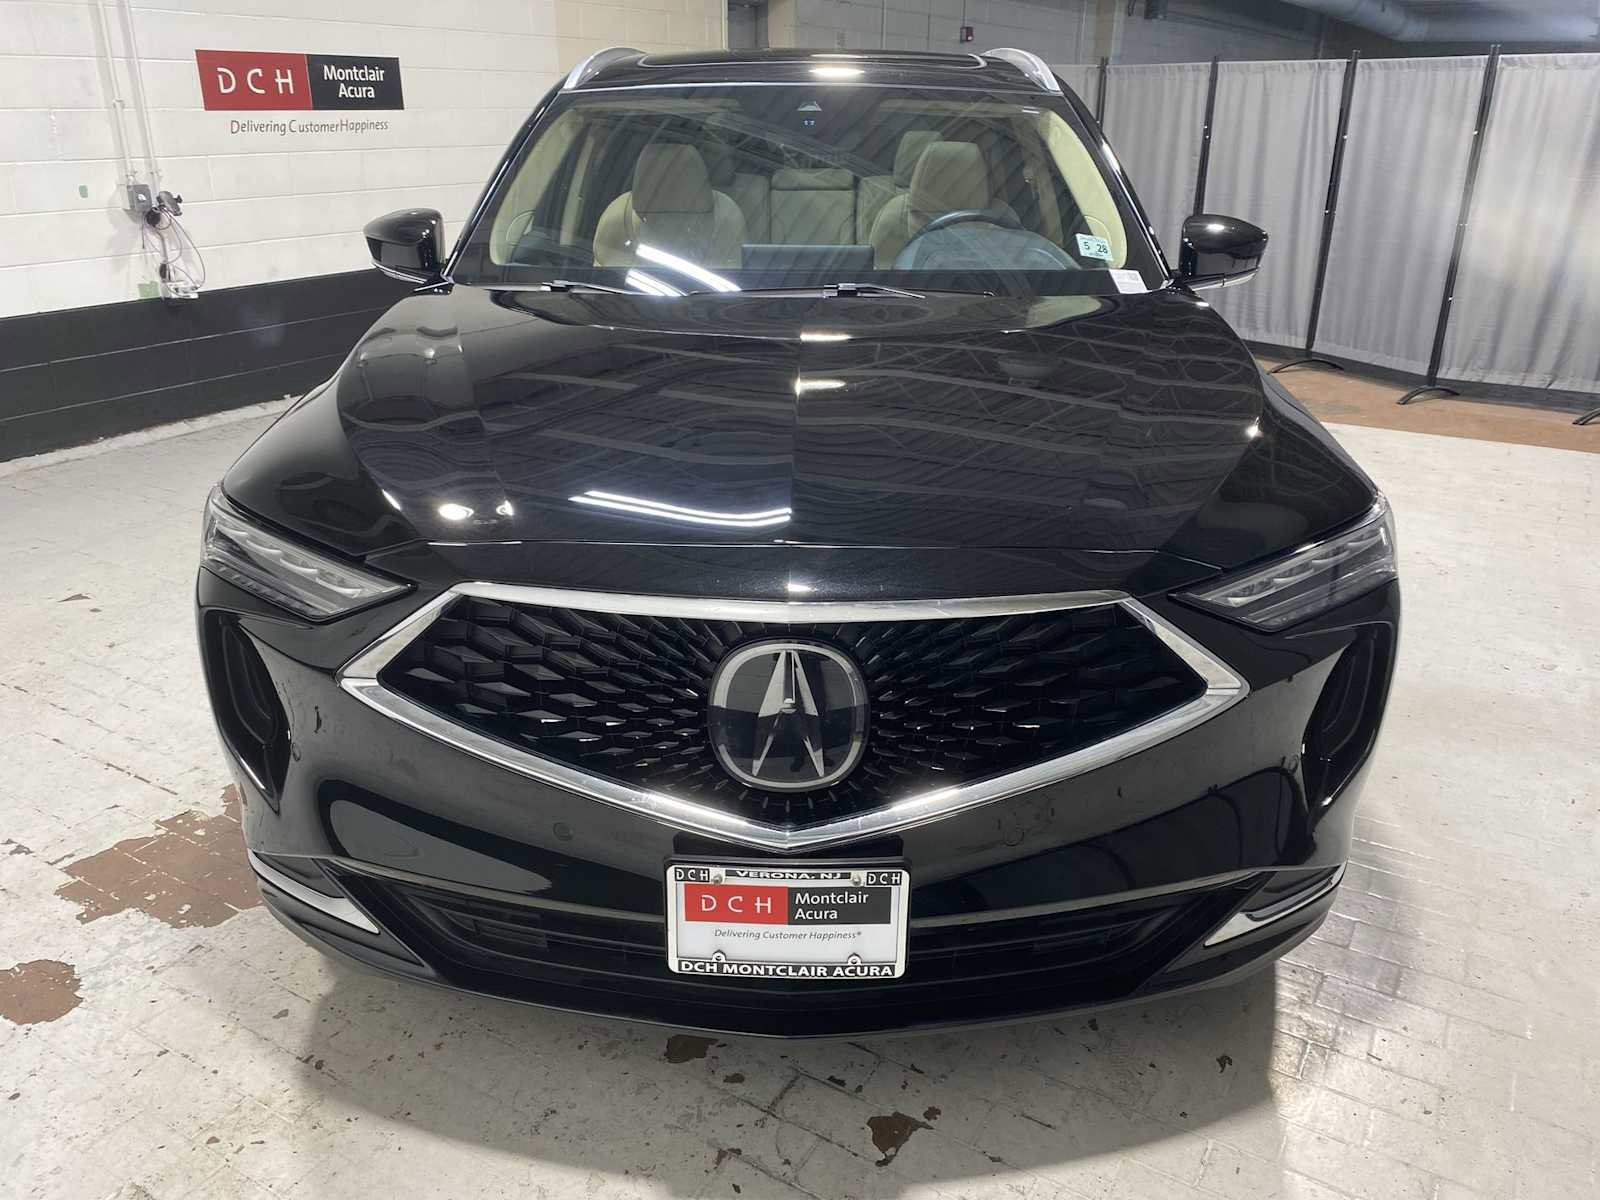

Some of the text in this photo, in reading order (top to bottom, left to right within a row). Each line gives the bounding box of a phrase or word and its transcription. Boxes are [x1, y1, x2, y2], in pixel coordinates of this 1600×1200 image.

[323, 65, 385, 82] Montclair
[216, 67, 295, 95] DCH
[338, 84, 376, 99] Acura
[230, 119, 287, 136] Delivering
[675, 868, 710, 882] DCH
[819, 872, 843, 881] NJ
[867, 871, 901, 885] DCH
[700, 894, 772, 914] DCH
[794, 892, 869, 905] Montclair
[794, 908, 838, 920] Acura
[714, 929, 761, 940] Delivering
[762, 931, 808, 939] Customer
[681, 961, 893, 978] DCH MONTCLAIR ACURA
